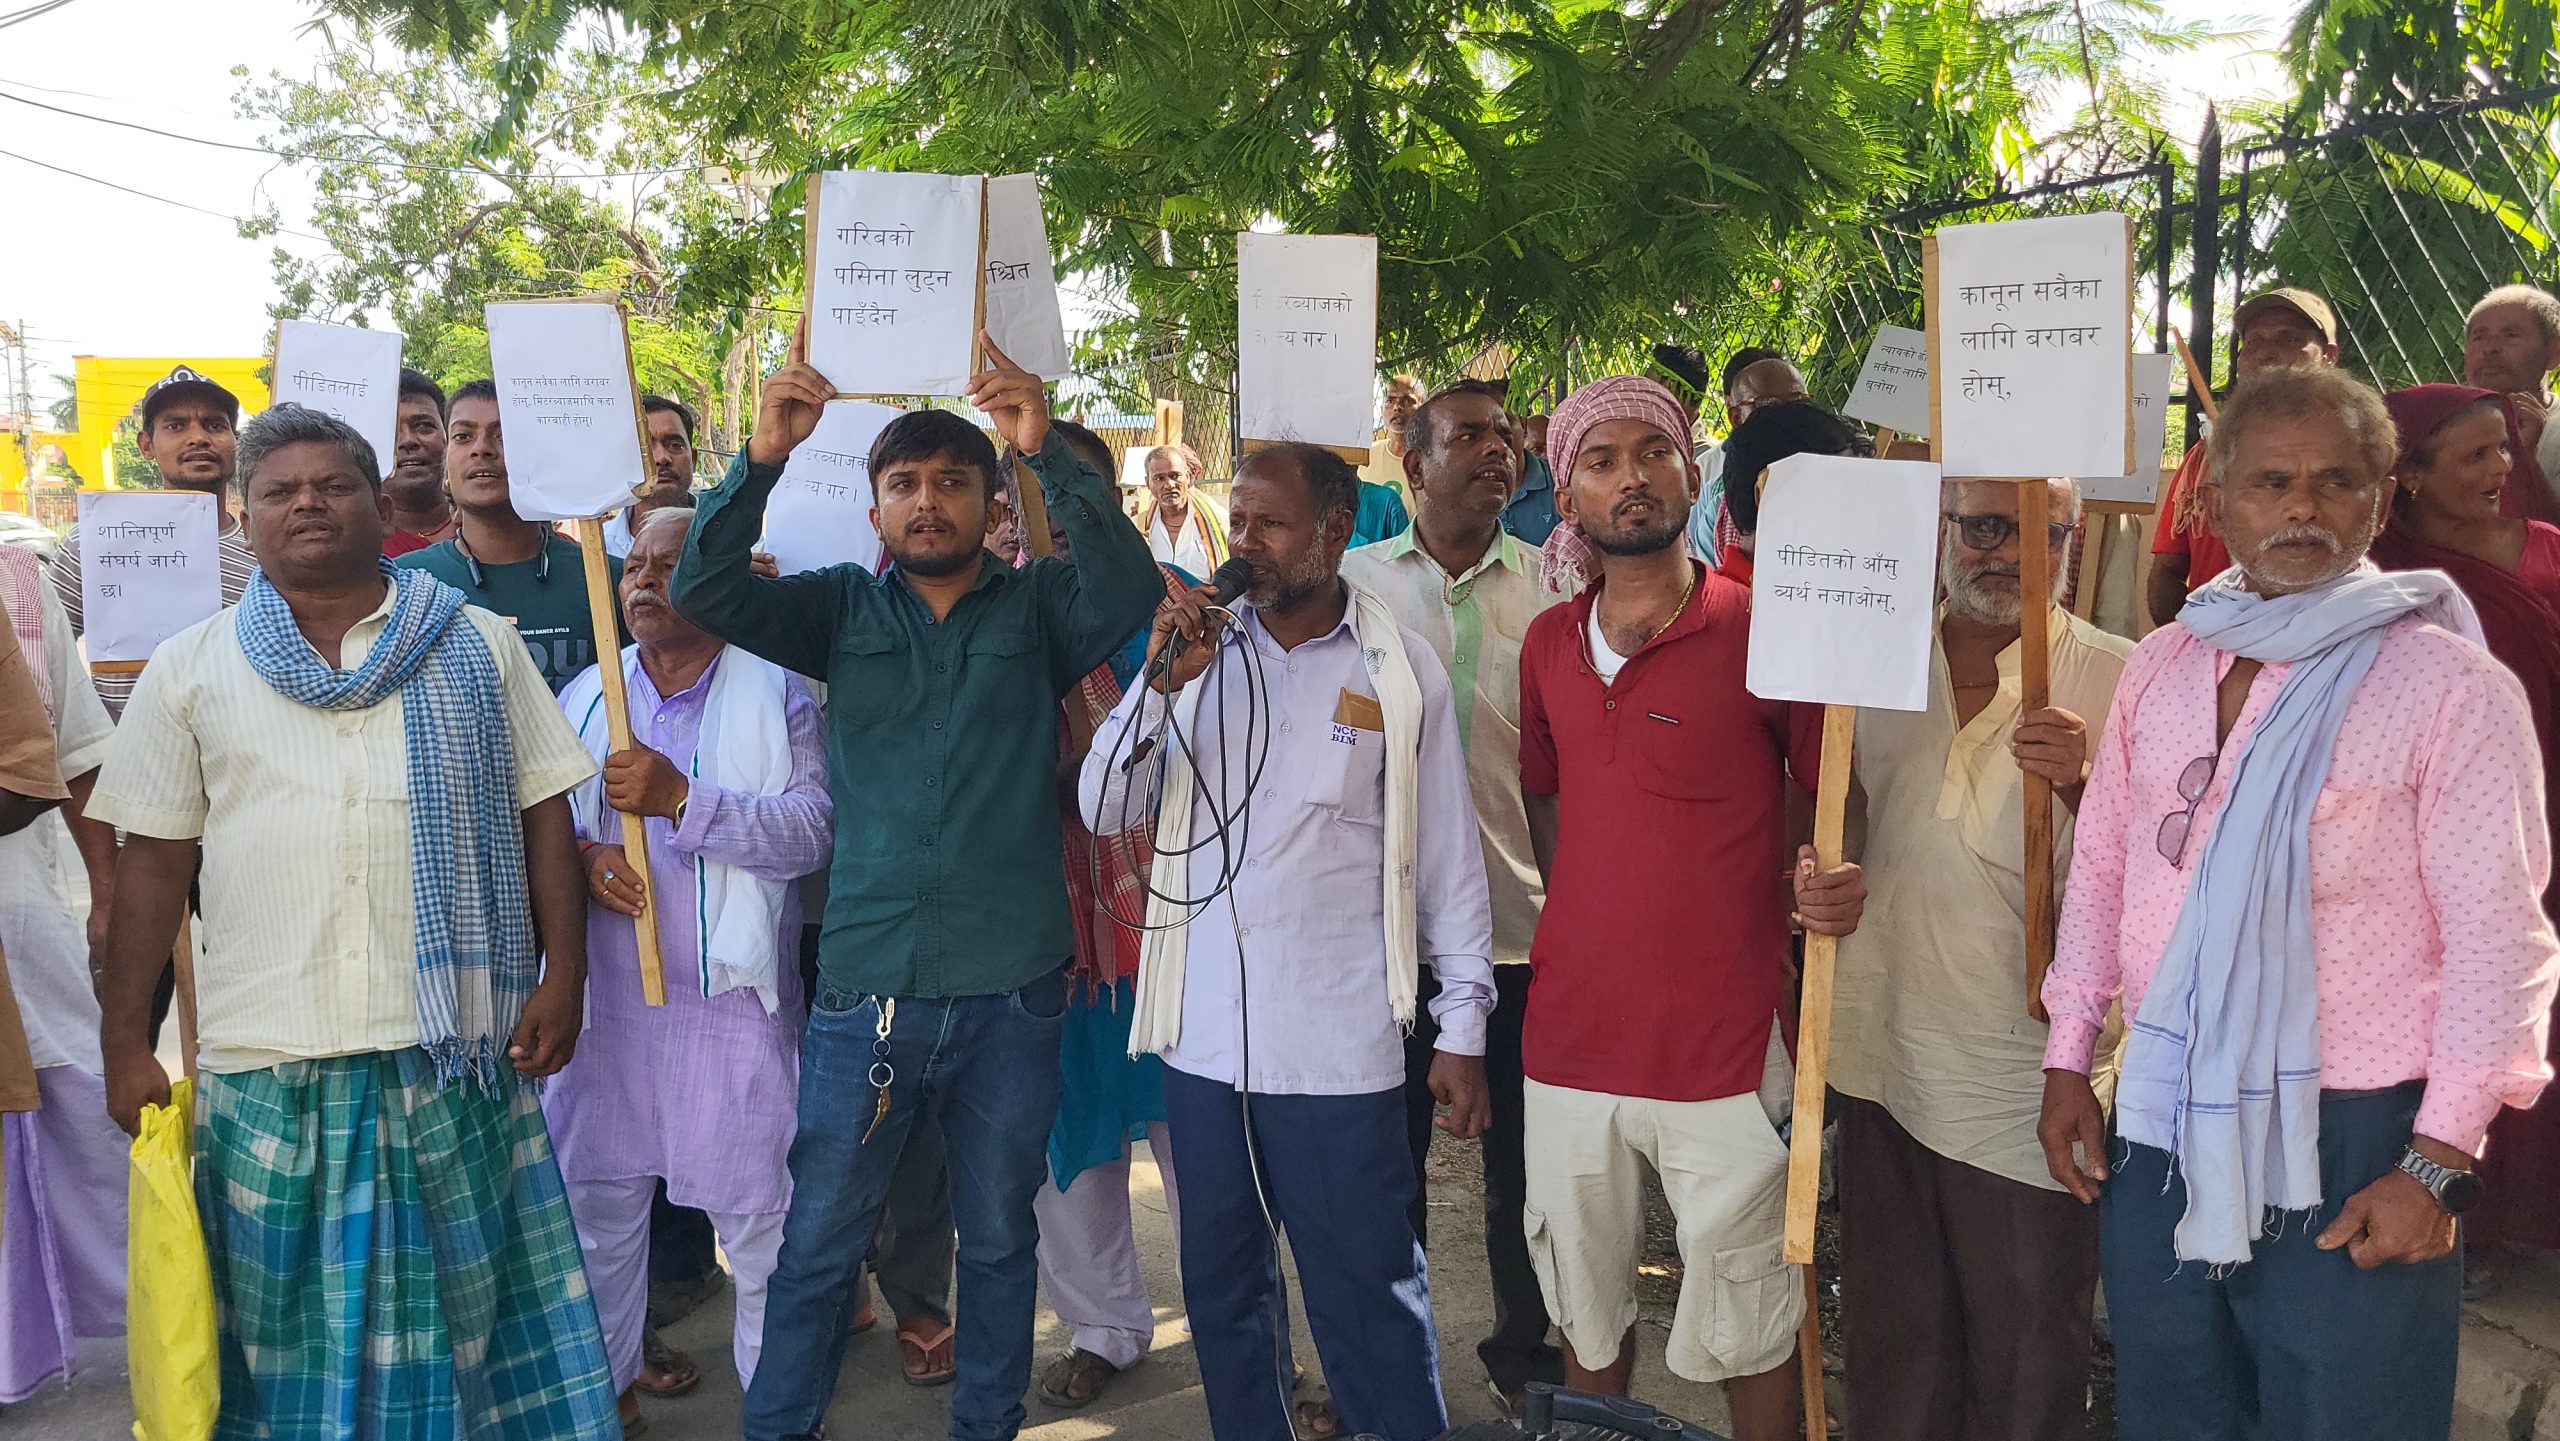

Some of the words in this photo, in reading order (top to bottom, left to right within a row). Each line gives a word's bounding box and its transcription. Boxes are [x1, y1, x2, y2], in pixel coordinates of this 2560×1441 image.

[836, 221, 915, 247] गरिबको
[833, 261, 898, 286] पसिना
[904, 269, 952, 293] लुट्न
[1959, 283, 2025, 311] कानून
[2032, 273, 2103, 301] सबैका
[831, 301, 898, 327] पाइँदैन
[1302, 331, 1327, 349] गर
[1959, 322, 2018, 350] लागि
[2024, 326, 2102, 348] बराबर
[293, 370, 369, 399] पीडितलाई
[827, 483, 848, 502] गर
[98, 521, 176, 544] शान्तिपूर्ण
[98, 550, 142, 568] संघर्ष
[147, 550, 188, 568] जारी
[1777, 544, 1856, 571] पीडितको
[99, 584, 122, 598] छ।
[1774, 581, 1812, 602] व्यर्थ
[1331, 733, 1358, 746] BIM
[1332, 724, 1359, 737] NCC
